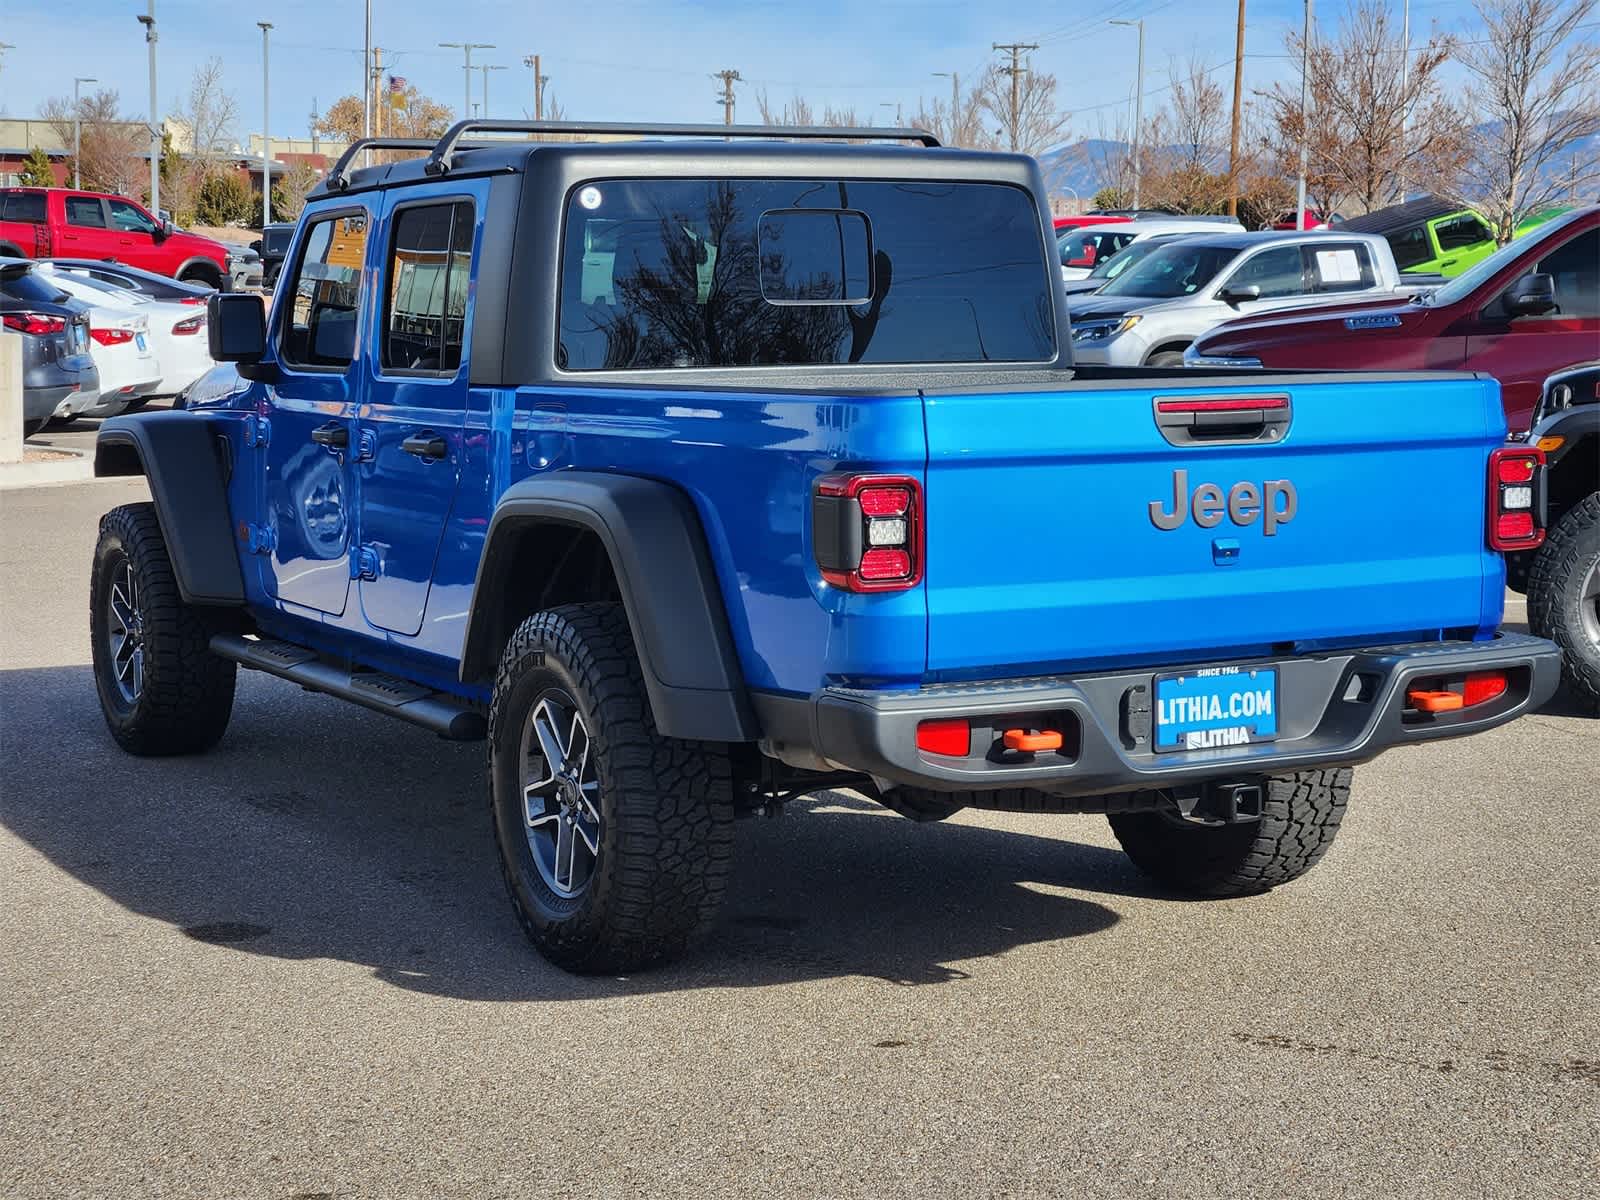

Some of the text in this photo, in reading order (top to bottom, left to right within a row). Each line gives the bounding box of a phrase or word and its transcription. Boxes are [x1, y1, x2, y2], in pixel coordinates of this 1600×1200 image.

[1149, 469, 1298, 536] Jeep
[1197, 667, 1220, 678] SINCE
[1158, 689, 1272, 726] LITHIA.COM
[1201, 726, 1250, 748] LITHIA
